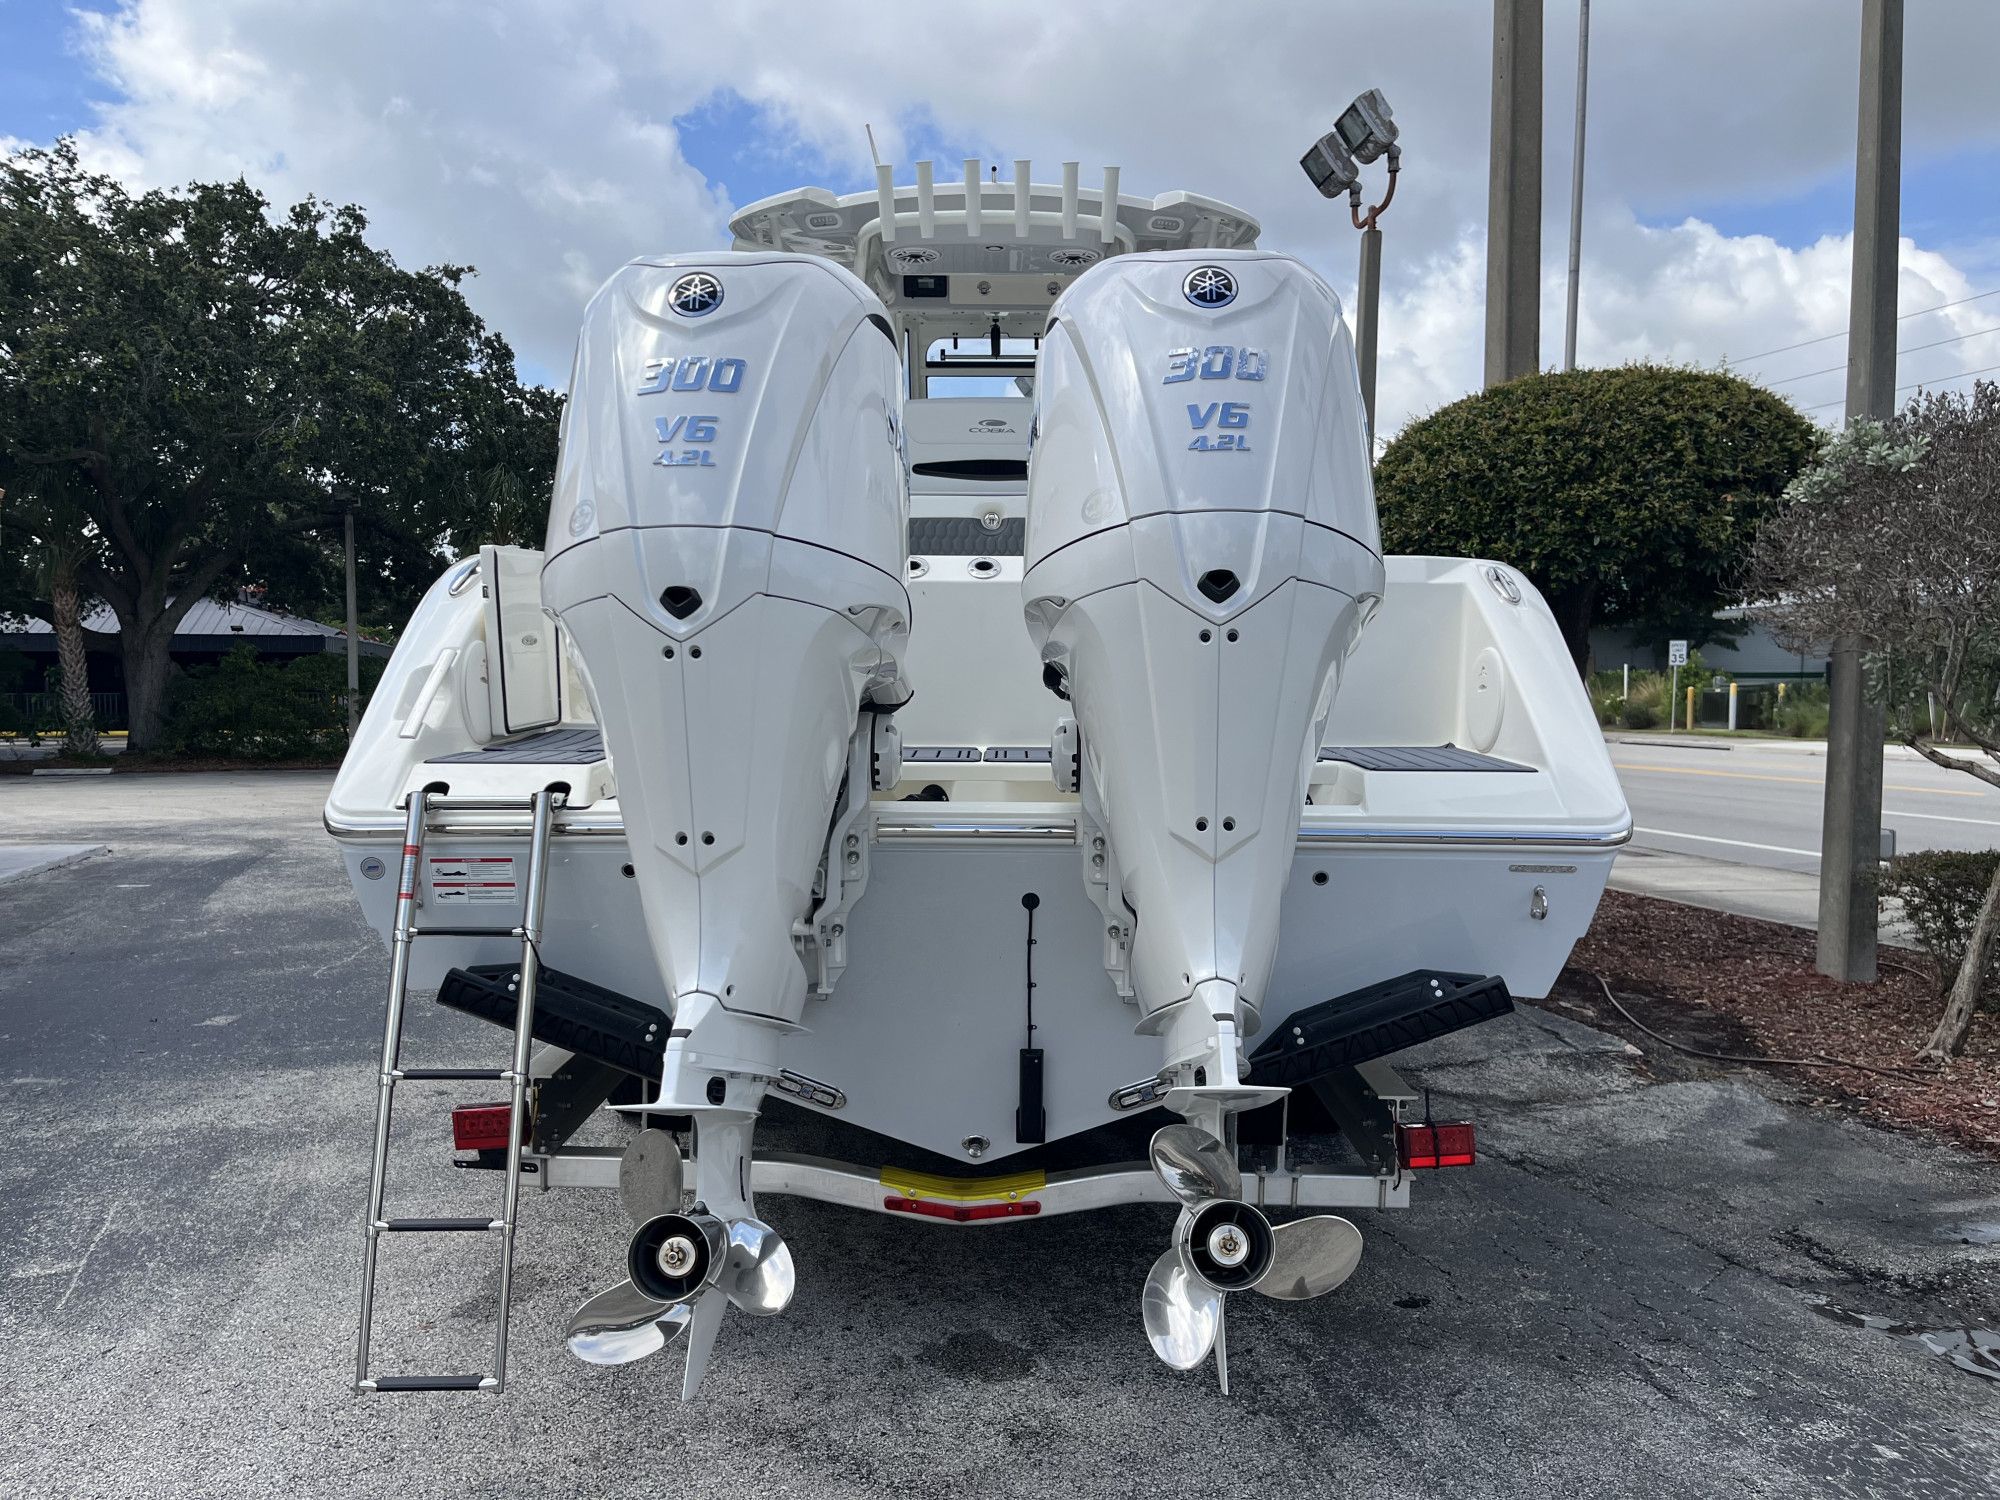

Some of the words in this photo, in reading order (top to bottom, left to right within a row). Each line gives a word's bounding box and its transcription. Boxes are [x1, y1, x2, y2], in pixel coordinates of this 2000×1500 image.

[637, 356, 746, 396] 300
[1162, 345, 1267, 384] 300
[655, 415, 719, 443] V6
[1186, 402, 1250, 429] V6
[1187, 434, 1251, 452] 4.2L
[652, 449, 717, 467] 4.2L
[1671, 653, 1685, 663] 35
